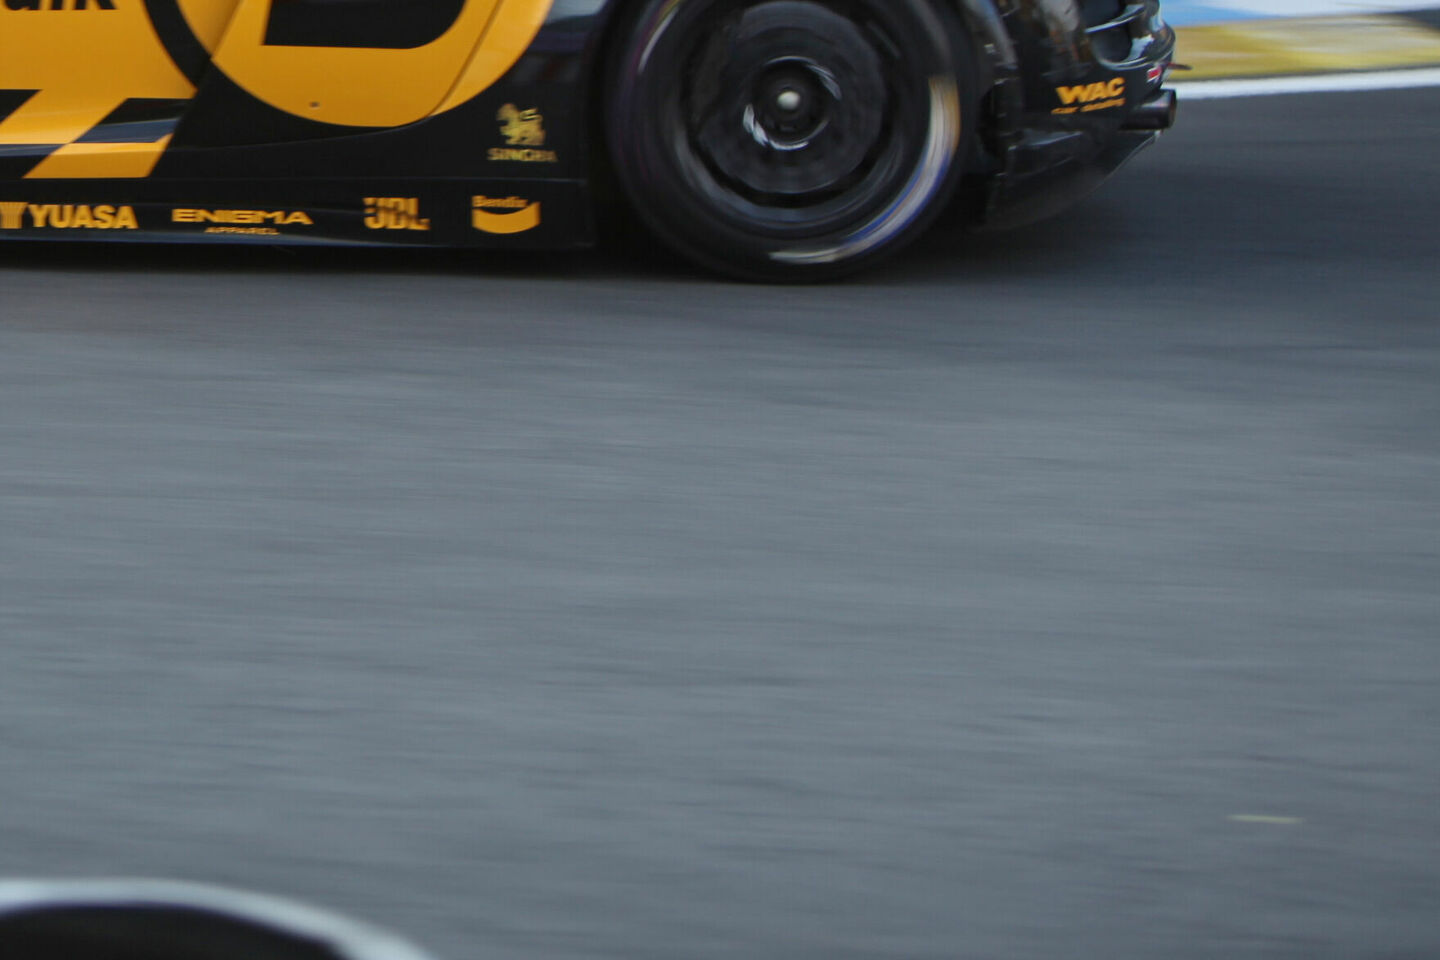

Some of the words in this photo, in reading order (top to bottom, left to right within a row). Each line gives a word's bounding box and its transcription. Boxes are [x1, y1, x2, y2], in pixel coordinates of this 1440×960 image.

[1055, 76, 1127, 105] WAC
[28, 203, 139, 229] YUASA
[171, 208, 315, 225] ENIGMA
